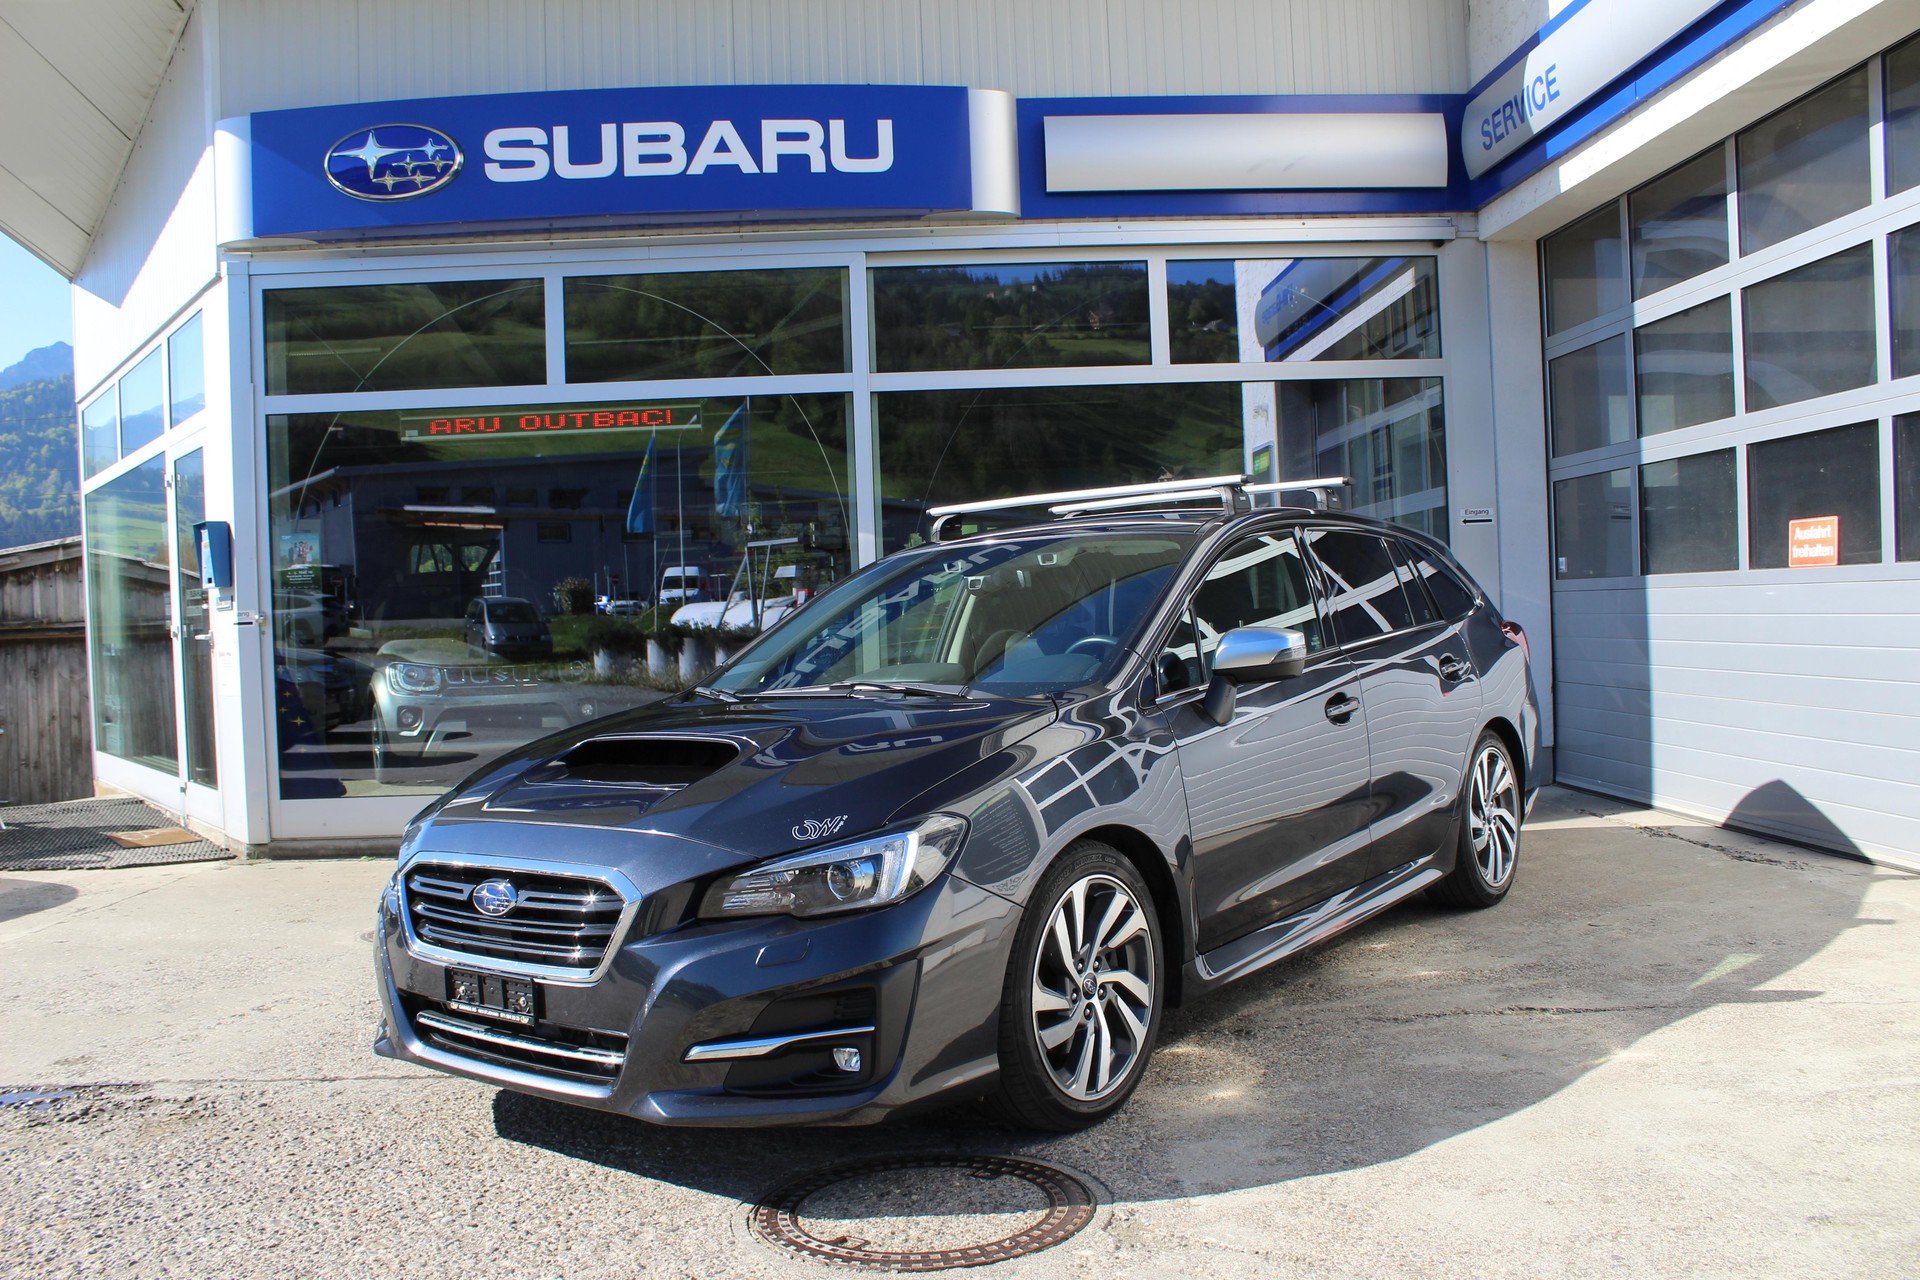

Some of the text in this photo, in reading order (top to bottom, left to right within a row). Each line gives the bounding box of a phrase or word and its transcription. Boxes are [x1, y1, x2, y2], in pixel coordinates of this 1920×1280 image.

[1481, 63, 1560, 150] SERVICE
[483, 119, 894, 183] SUBARU
[429, 416, 500, 434] ARU
[1794, 525, 1832, 540] Ausfahrt
[1793, 544, 1834, 559] freihalten
